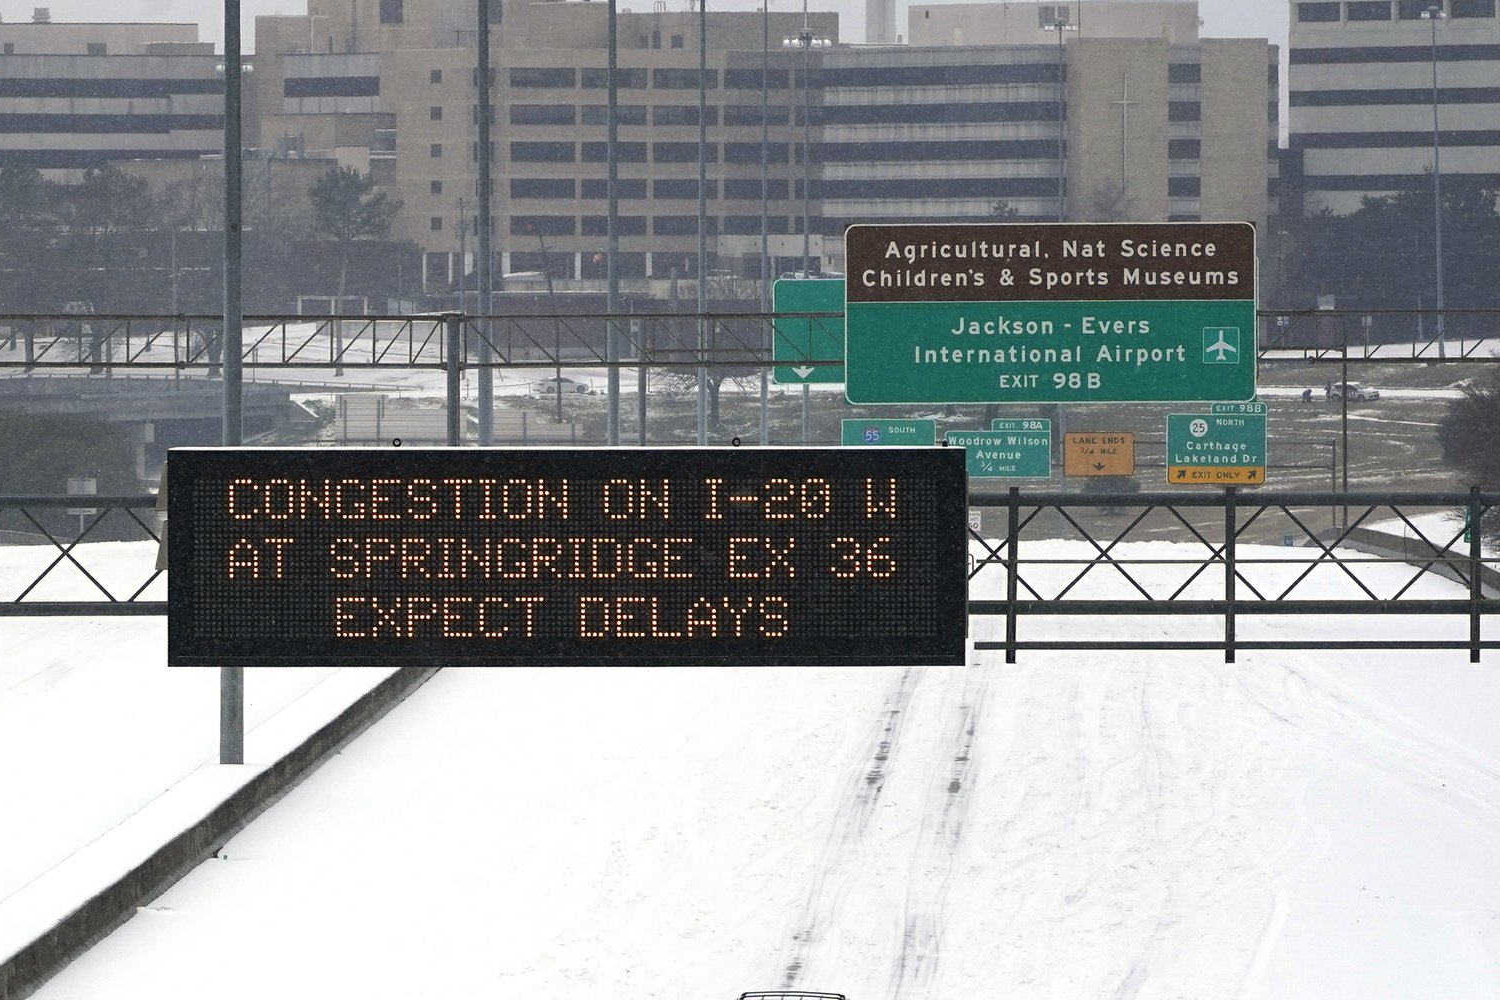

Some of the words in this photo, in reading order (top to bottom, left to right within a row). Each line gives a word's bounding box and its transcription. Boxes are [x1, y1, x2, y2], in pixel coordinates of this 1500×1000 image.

[884, 240, 1050, 263] Agricultural,
[1063, 240, 1106, 258] Nat
[1120, 239, 1217, 258] Science
[862, 268, 986, 287] Children's
[999, 268, 1015, 286] &
[1029, 268, 1110, 290] Sports
[1123, 268, 1240, 286] Museums
[951, 316, 1054, 335] Jackson
[1082, 317, 1150, 334] Evers
[914, 346, 1080, 364] International
[1098, 345, 1186, 367] Airport
[999, 374, 1038, 388] EXIT
[1216, 404, 1234, 412] EXIT
[1239, 404, 1262, 413] 98B
[1022, 421, 1043, 430] 98A
[1216, 418, 1245, 426] NORTH
[888, 425, 916, 434] SOUTH
[1192, 423, 1206, 433] 25
[865, 430, 880, 441] 55
[1072, 436, 1097, 445] LANE
[1102, 436, 1125, 445] ENDS
[948, 436, 1002, 446] Woodrow
[1007, 436, 1048, 446] Wilson
[1186, 441, 1247, 453] Carthage
[976, 450, 1021, 460] Avenue
[1175, 454, 1237, 463] Lakeland
[1243, 454, 1258, 463] Dr
[1192, 471, 1211, 479] EXIT
[1216, 471, 1241, 479] ONLY
[227, 477, 568, 520] CONGESTION
[603, 477, 670, 520] ON
[704, 477, 831, 520] I-20
[865, 477, 897, 520] W
[228, 537, 295, 580] AT
[329, 537, 694, 580] SPRINGRIDGE
[728, 537, 796, 579] EX
[830, 537, 897, 579] 36
[335, 595, 545, 639] EXPECT
[579, 595, 789, 639] DELAYS
